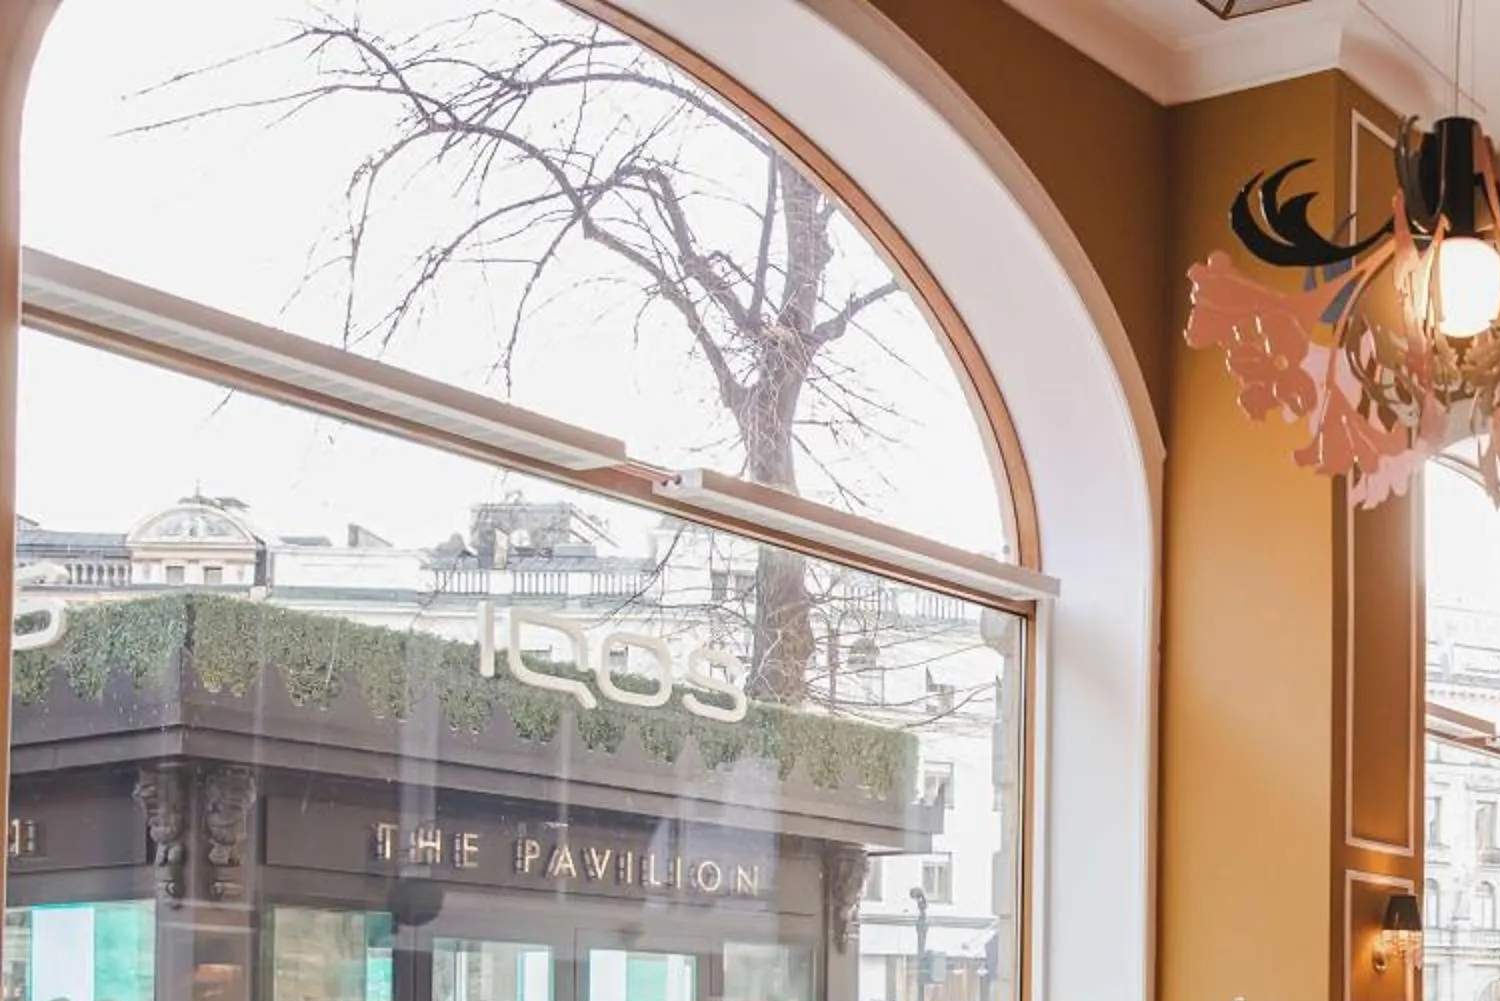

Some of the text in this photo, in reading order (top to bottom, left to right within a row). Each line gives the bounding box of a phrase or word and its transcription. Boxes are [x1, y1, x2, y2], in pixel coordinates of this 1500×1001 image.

[478, 600, 747, 723] IQOS
[374, 822, 760, 896] THE PAVILION
